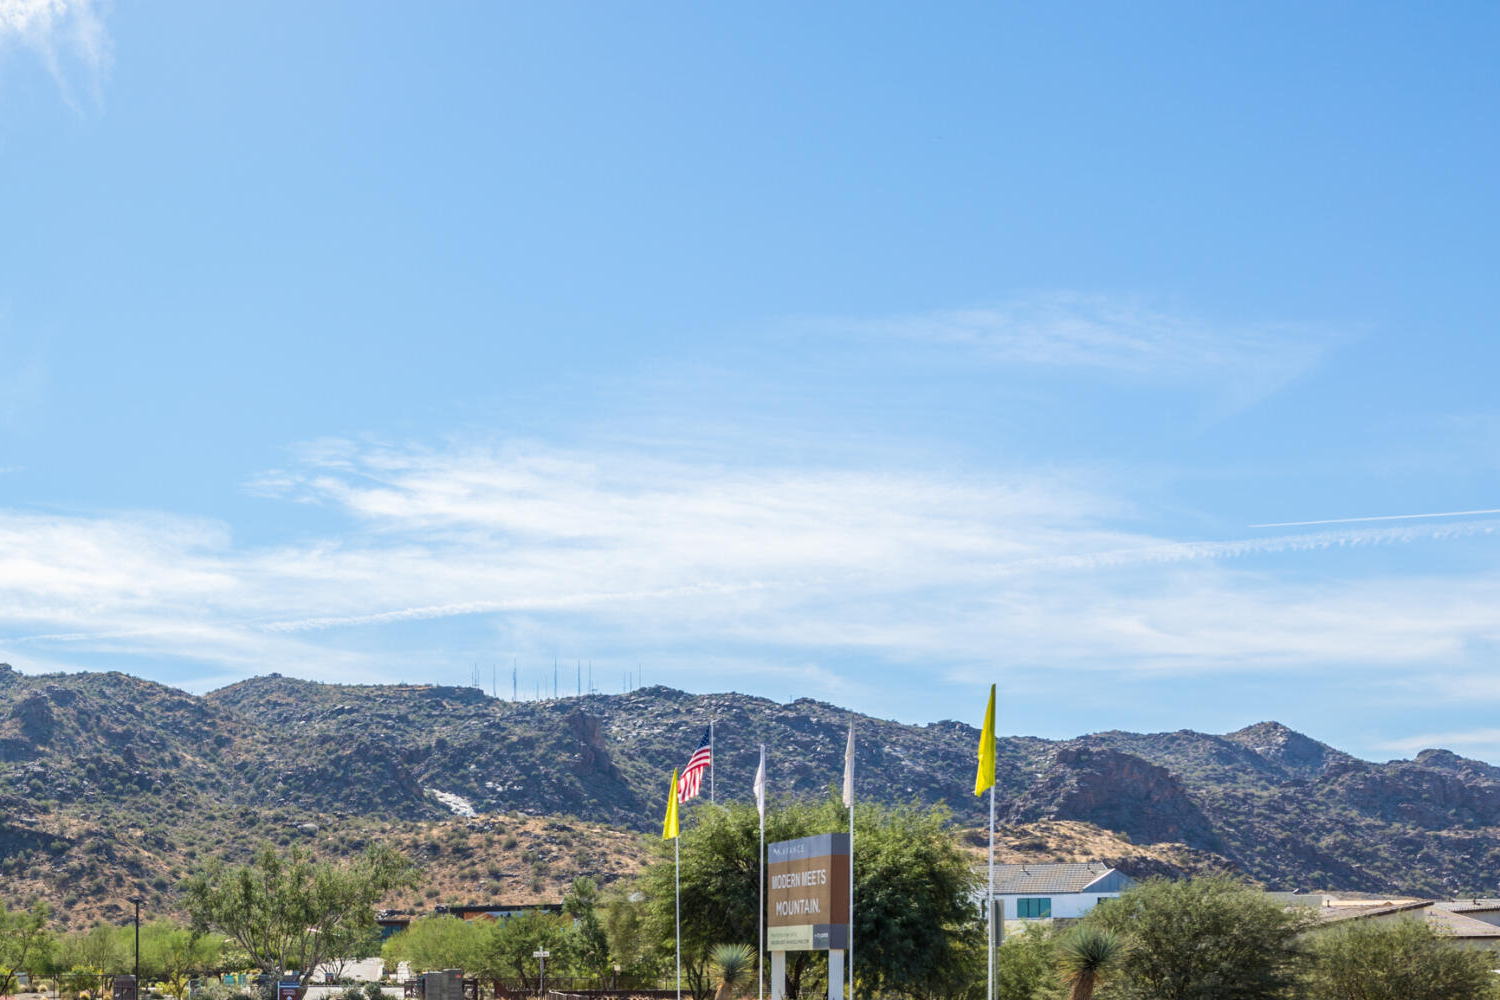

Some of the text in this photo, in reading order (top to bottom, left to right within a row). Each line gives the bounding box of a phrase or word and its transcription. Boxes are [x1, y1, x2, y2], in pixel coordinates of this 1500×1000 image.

[772, 869, 826, 889] MODERN MEETS
[776, 899, 820, 915] MOUNTAIN.
